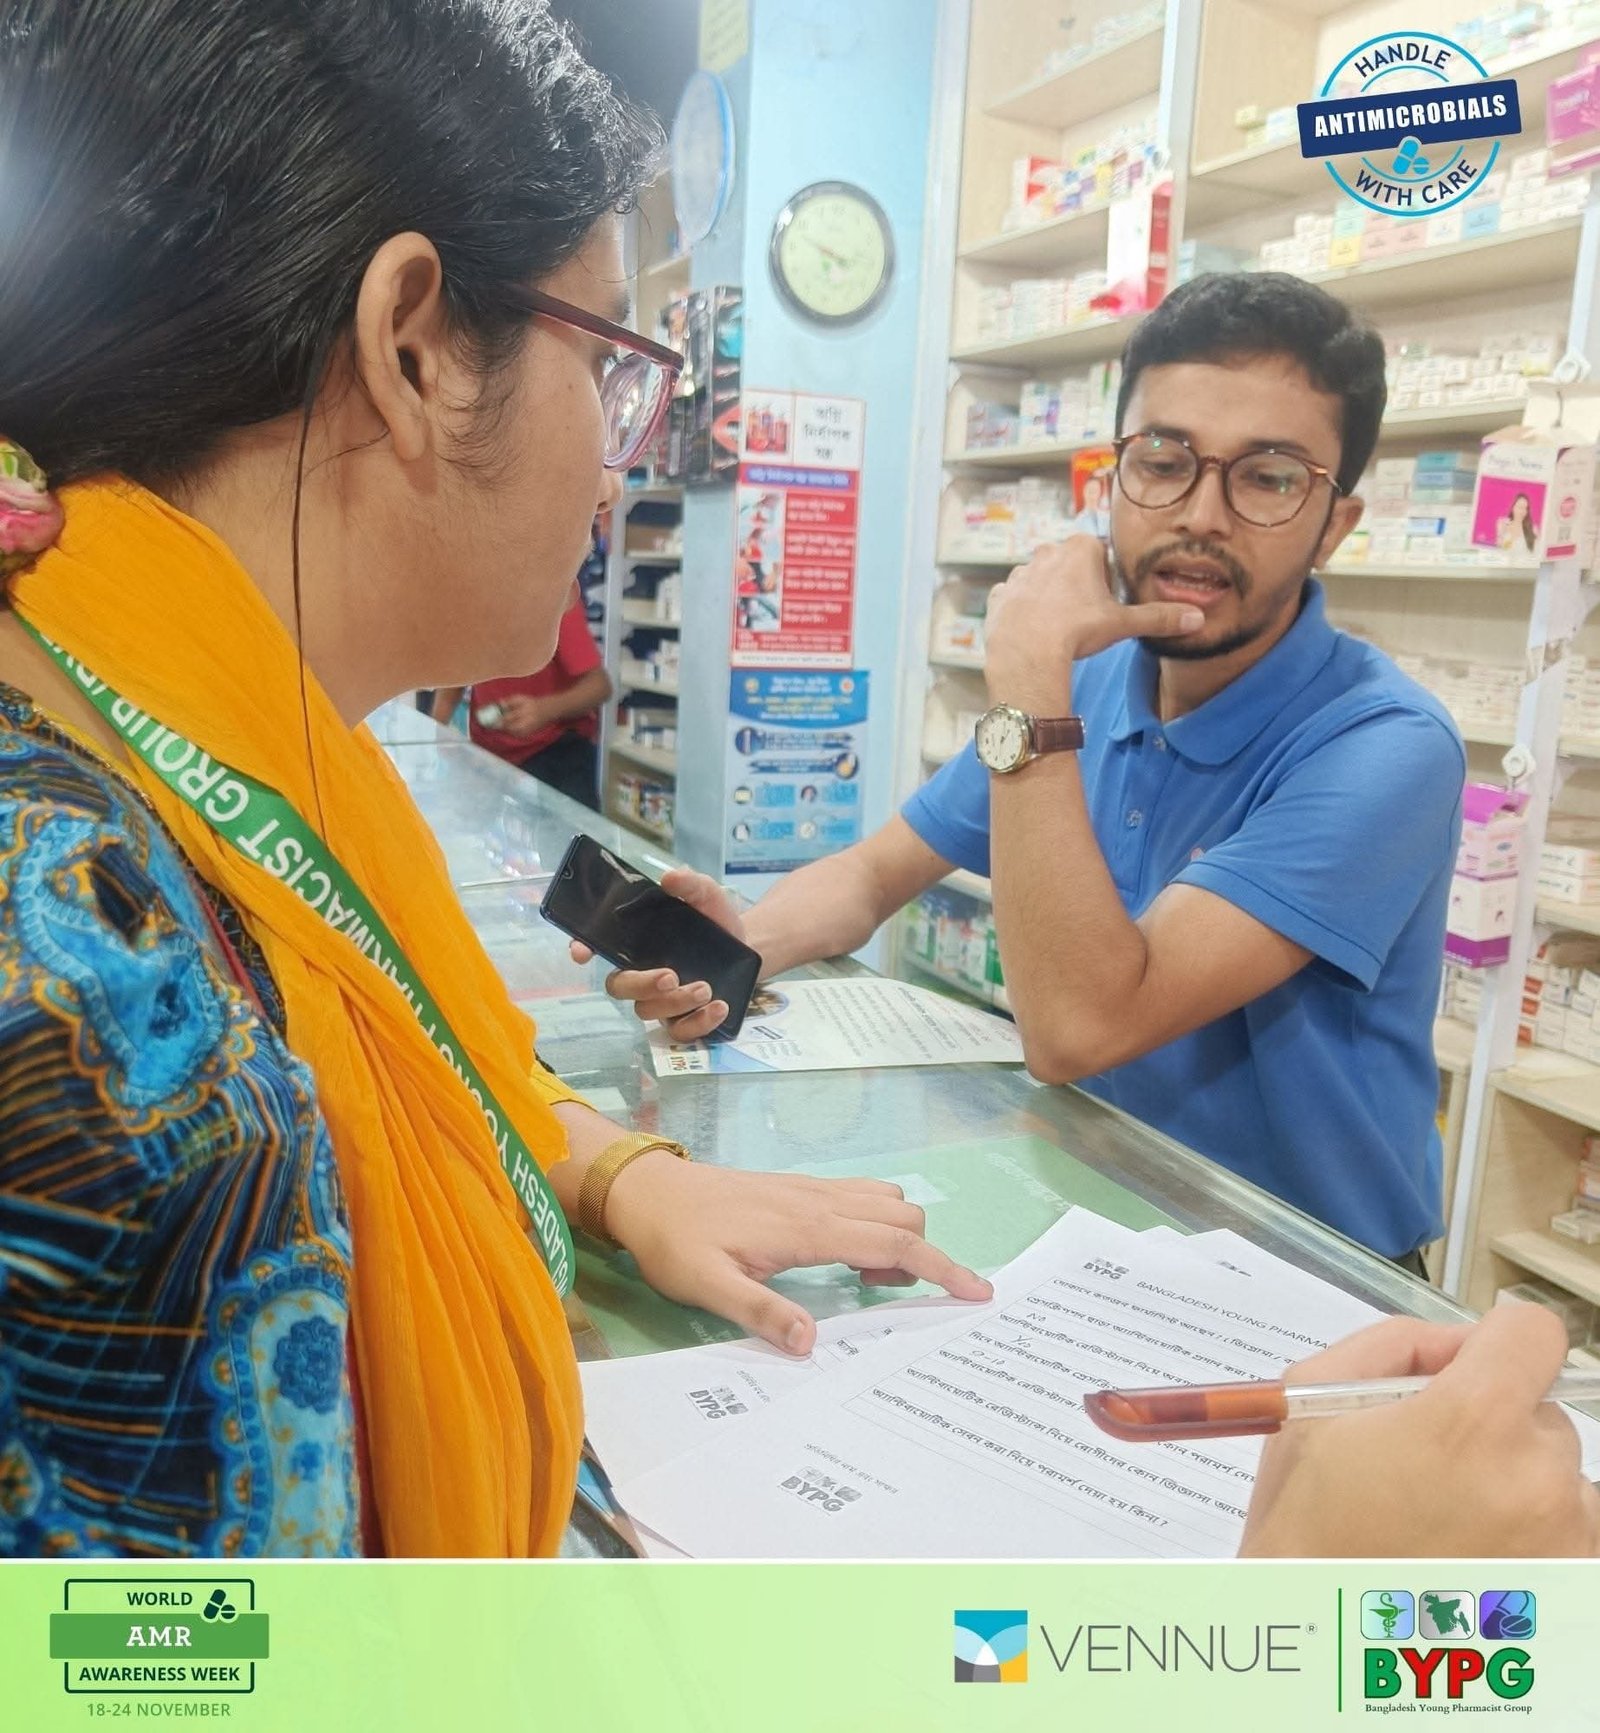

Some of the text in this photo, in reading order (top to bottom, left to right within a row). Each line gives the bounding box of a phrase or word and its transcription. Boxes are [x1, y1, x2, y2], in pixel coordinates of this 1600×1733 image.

[1083, 1262, 1122, 1279] BYPG
[1053, 1277, 1092, 1295] দোকানে
[1179, 1321, 1215, 1337] আছেন
[1135, 1280, 1223, 1312] BANGLADESH
[1220, 1308, 1267, 1328] YOUNG
[968, 1330, 993, 1343] দিনে
[993, 1340, 1072, 1373] অ্যান্টিবায়োটিক
[999, 1313, 1076, 1343] অ্যান্টিবায়োটিক
[1132, 1361, 1161, 1375] নিয়ে
[1026, 1296, 1086, 1319] প্রেসক্রিপশন
[1086, 1315, 1112, 1327] ছাড়া
[1112, 1324, 1191, 1355] অ্যান্টিবায়োটিক
[1191, 1354, 1222, 1367] প্রদান
[1223, 1364, 1247, 1376] করা
[689, 1389, 727, 1419] BYPG
[938, 1349, 1017, 1382] অ্যান্টিবায়োটিক
[1016, 1378, 1077, 1408] রেজিস্ট্যান্স
[1190, 1448, 1237, 1474] পরামর্শ
[872, 1385, 953, 1428] অ্যান্টিবায়োটিক
[949, 1423, 984, 1443] সেবন
[983, 1439, 1007, 1455] করা
[1005, 1449, 1036, 1467] নিয়ে
[1037, 1462, 1083, 1486] পরামর্শ
[1077, 1484, 1108, 1500] দেয়া
[1107, 1496, 1128, 1509] হয়
[1127, 1504, 1160, 1523] কিনা
[906, 1365, 986, 1406] অ্যান্টিবায়োটিক
[981, 1399, 1047, 1432] রেজিস্ট্যান্স
[1044, 1427, 1074, 1444] নিয়ে
[1071, 1441, 1127, 1468] রোগীদের
[1126, 1465, 1159, 1482] কোন
[1158, 1477, 1212, 1504] জিজ্ঞাসা
[781, 1475, 845, 1512] BYPG
